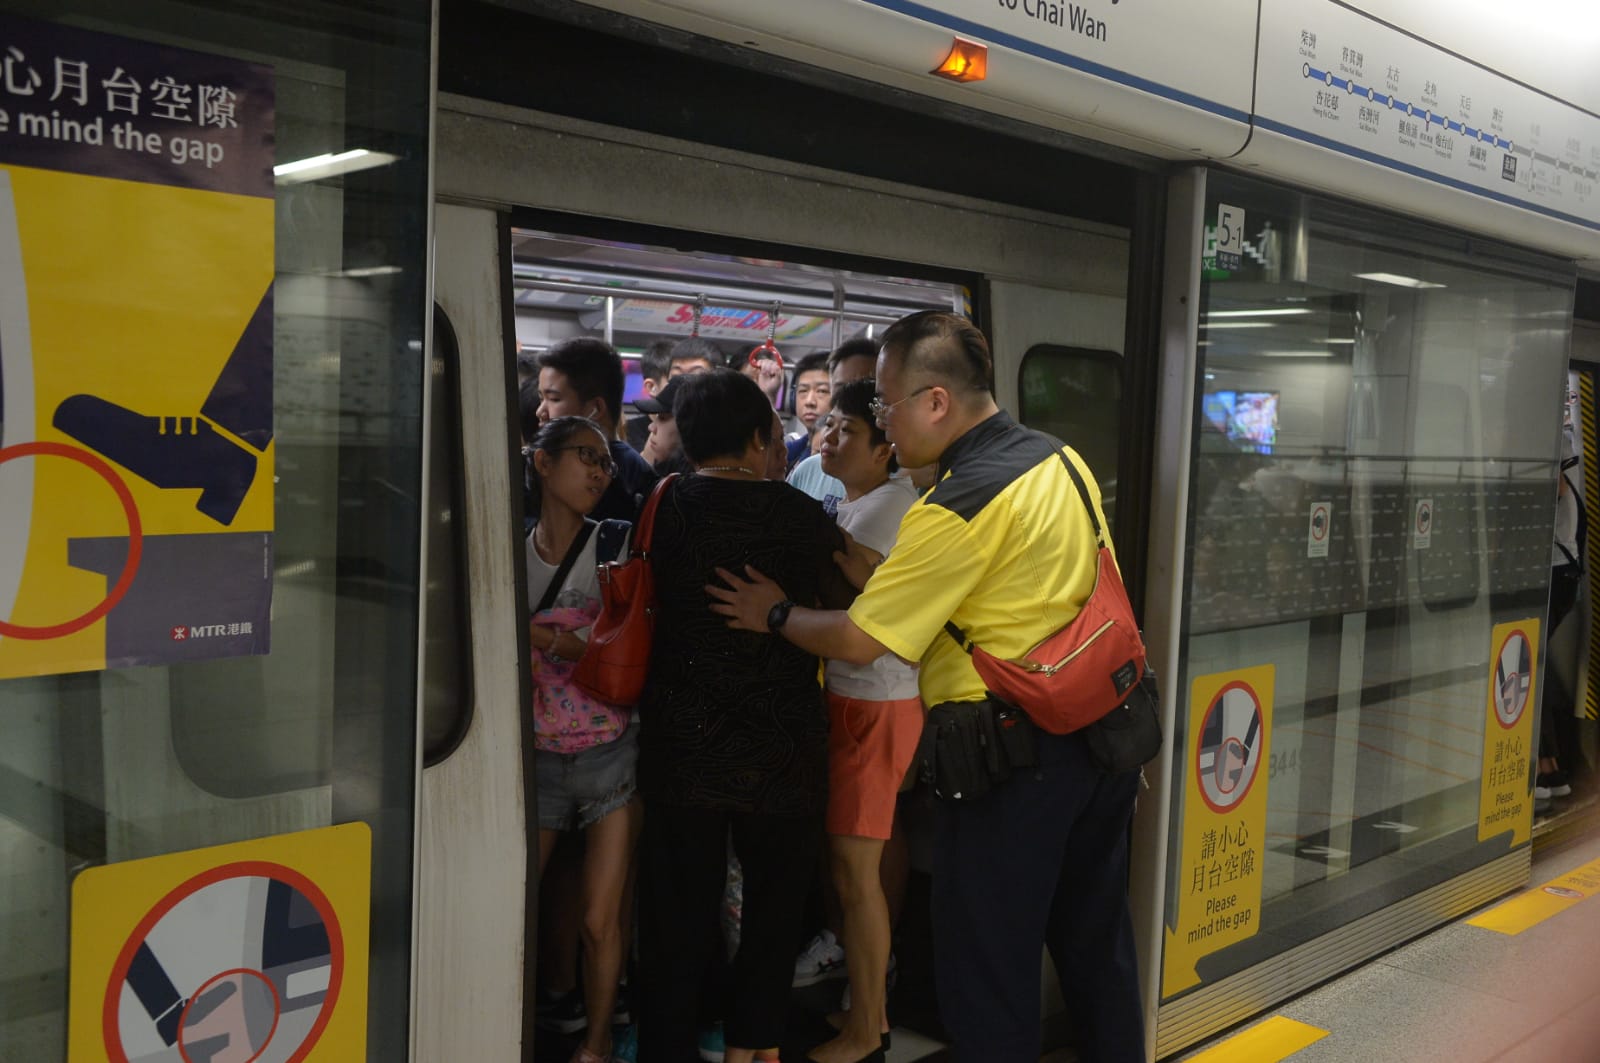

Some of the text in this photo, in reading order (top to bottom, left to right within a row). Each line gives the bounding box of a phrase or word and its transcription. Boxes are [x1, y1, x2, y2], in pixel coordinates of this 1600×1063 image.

[998, 0, 1106, 42] o Chai Wan
[0, 46, 238, 129] 心月台空隙
[19, 110, 102, 145] mind
[111, 121, 162, 154] the
[170, 136, 224, 168] gap
[1220, 212, 1242, 249] 5-1
[190, 622, 253, 638] MTR 港鐵
[1201, 820, 1248, 860] 請小心
[1190, 847, 1255, 896] 月台空隙
[1206, 894, 1237, 916] Please
[1187, 909, 1251, 944] mind the gap
